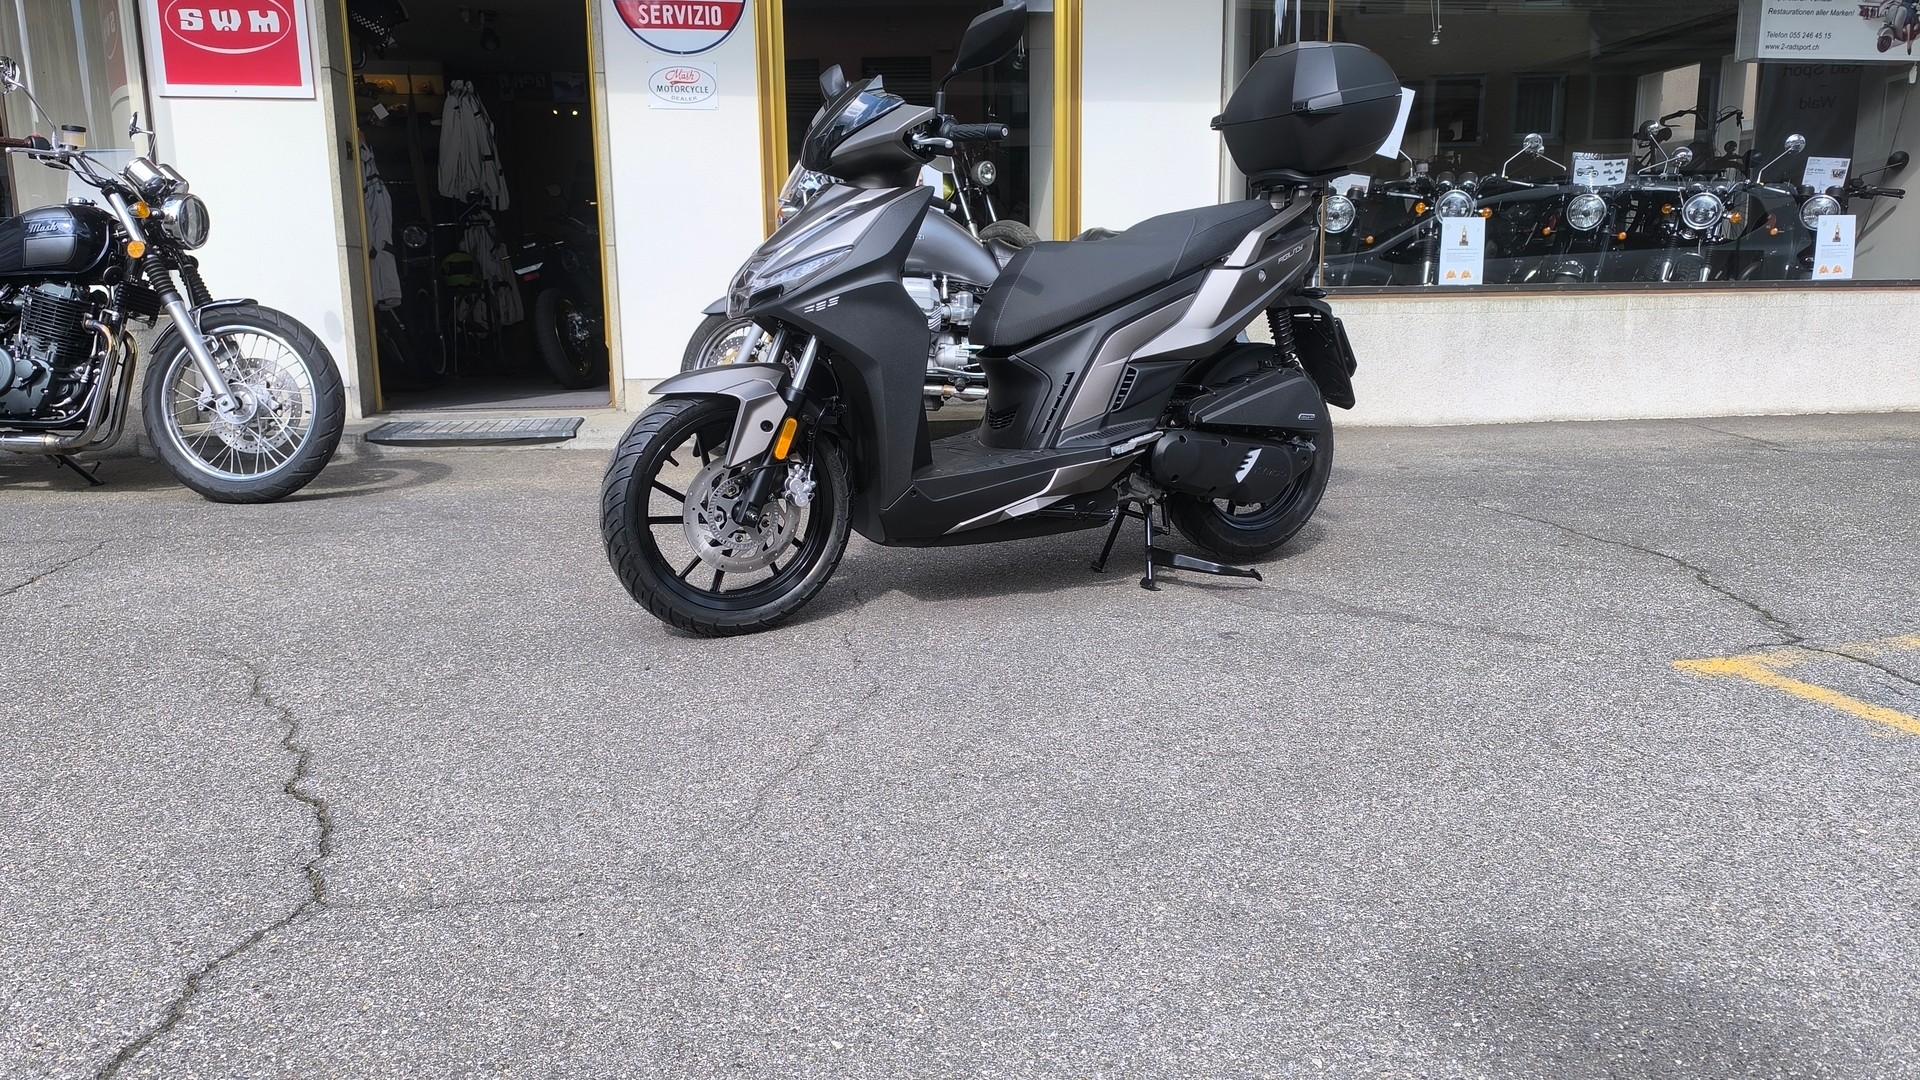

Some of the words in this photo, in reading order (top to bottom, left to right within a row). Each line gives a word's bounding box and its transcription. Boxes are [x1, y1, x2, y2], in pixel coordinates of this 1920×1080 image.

[638, 4, 722, 26] SERVIZIO
[1768, 7, 1814, 16] Restaurationen
[1830, 9, 1855, 17] Marken!
[177, 8, 280, 33] SWM
[1767, 31, 1788, 39] Telefon
[1789, 31, 1801, 39] 055
[1824, 32, 1832, 40] 15
[1765, 43, 1820, 51] www.2-radsport.ch
[665, 68, 697, 81] Mash
[656, 85, 709, 94] MOTORCYCLE
[29, 221, 59, 233] Mash
